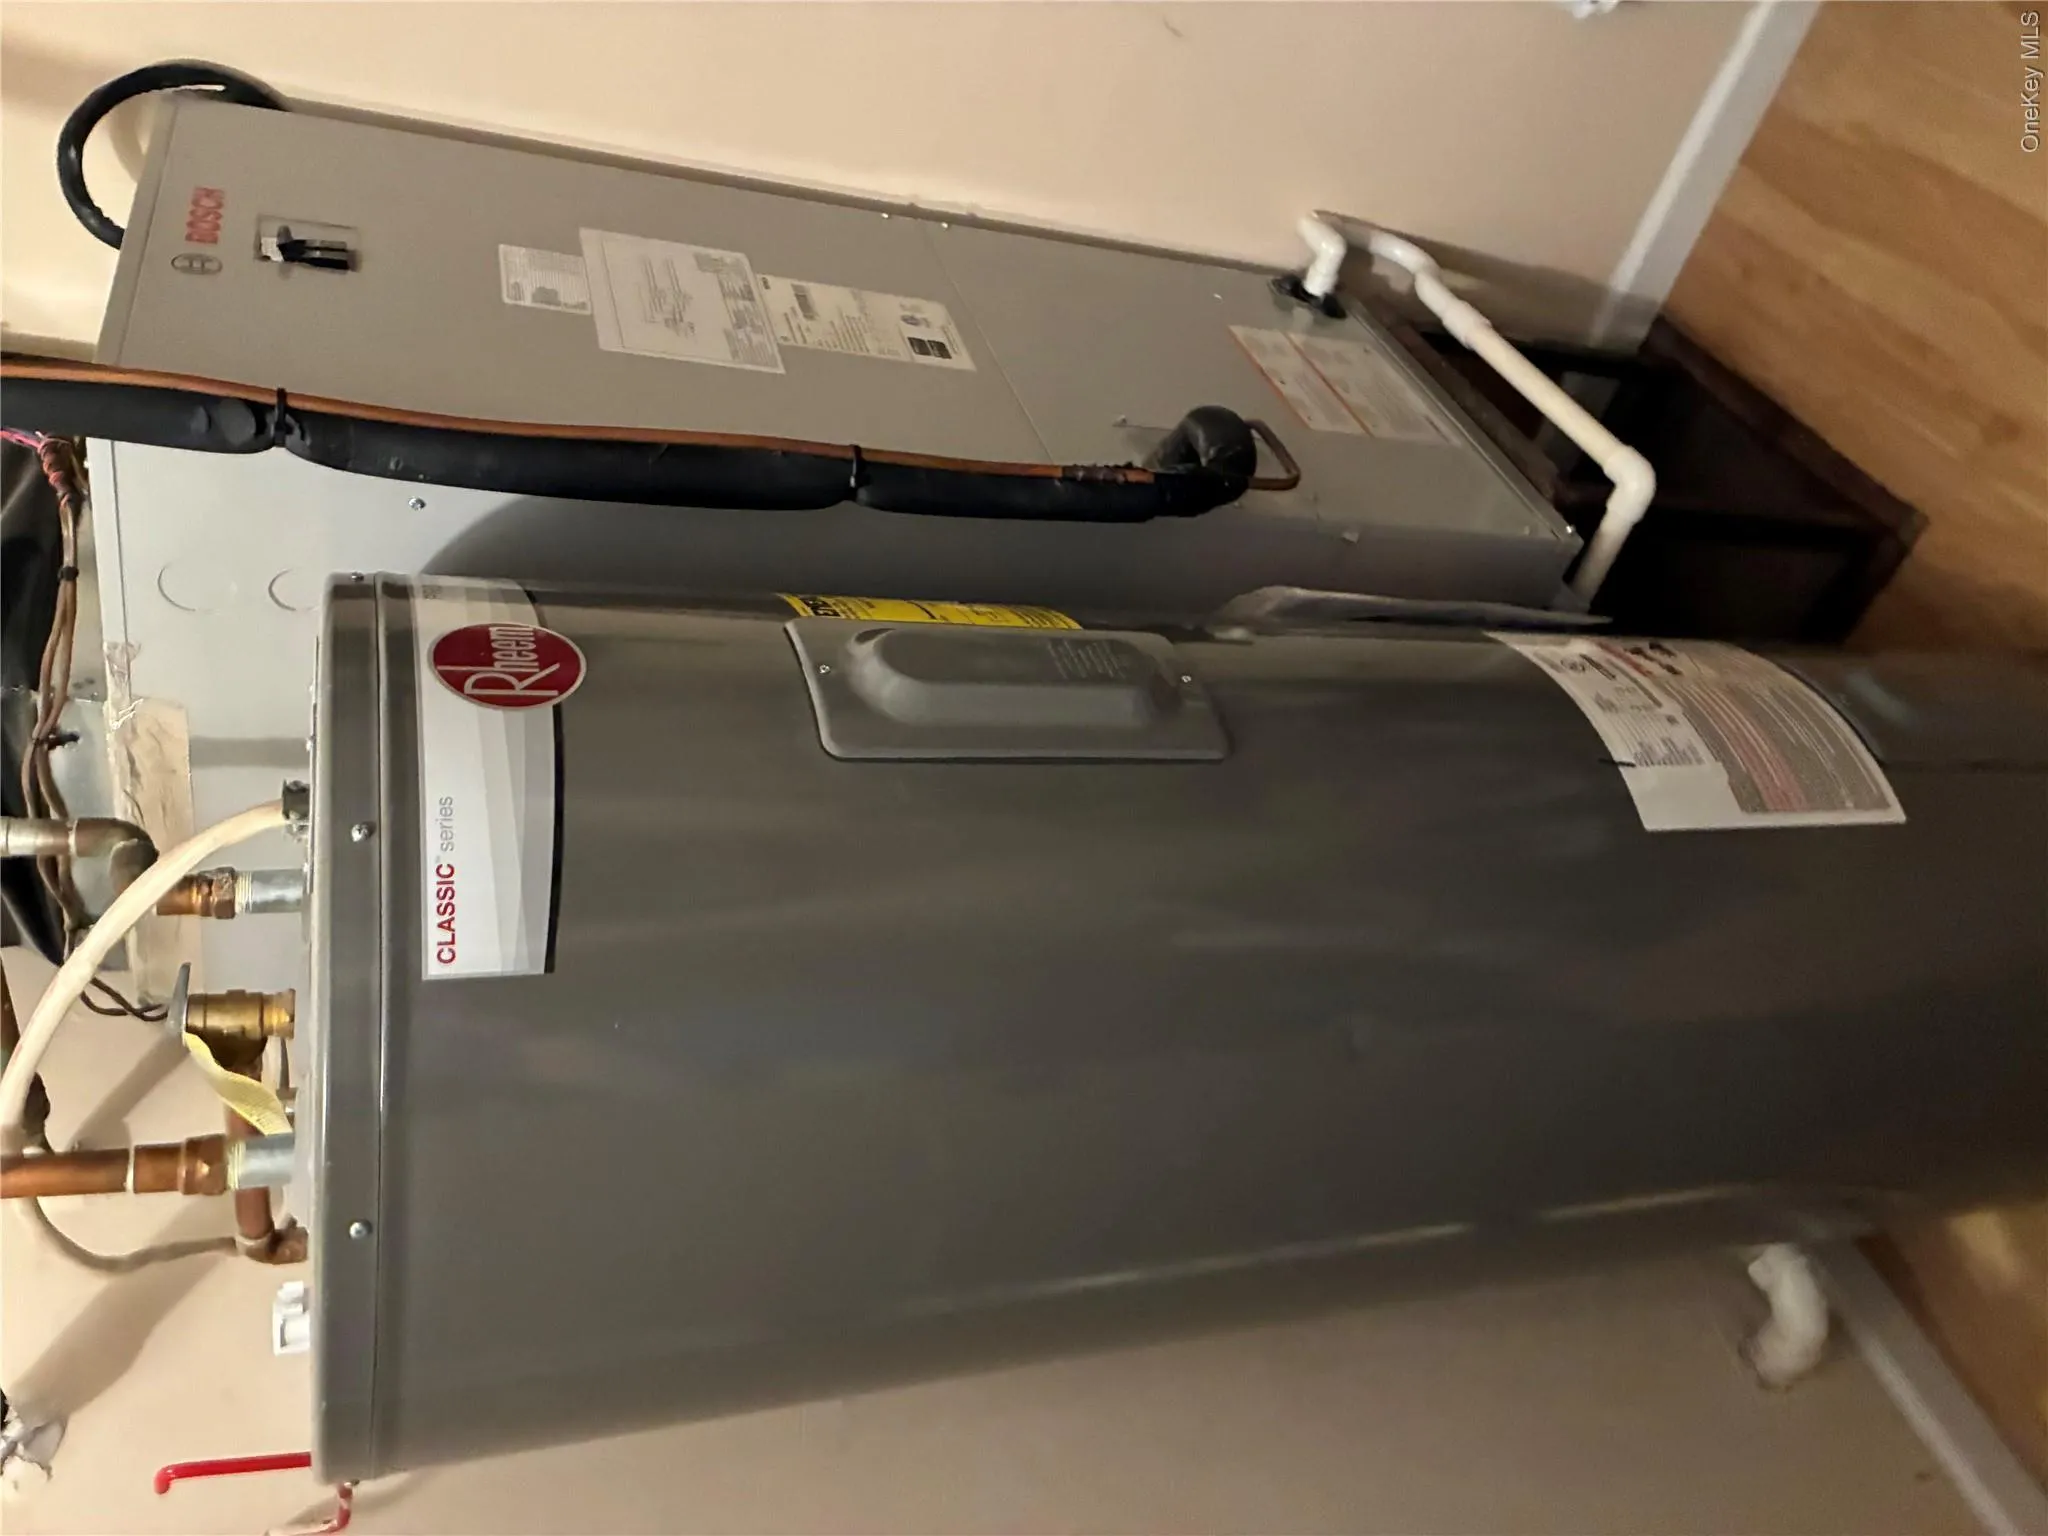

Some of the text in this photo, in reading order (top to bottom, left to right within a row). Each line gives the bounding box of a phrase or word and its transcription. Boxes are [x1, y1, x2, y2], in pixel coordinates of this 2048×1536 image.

[185, 187, 224, 245] BOSCH
[436, 626, 560, 696] Rheem
[436, 796, 456, 965] CLASSIC series
